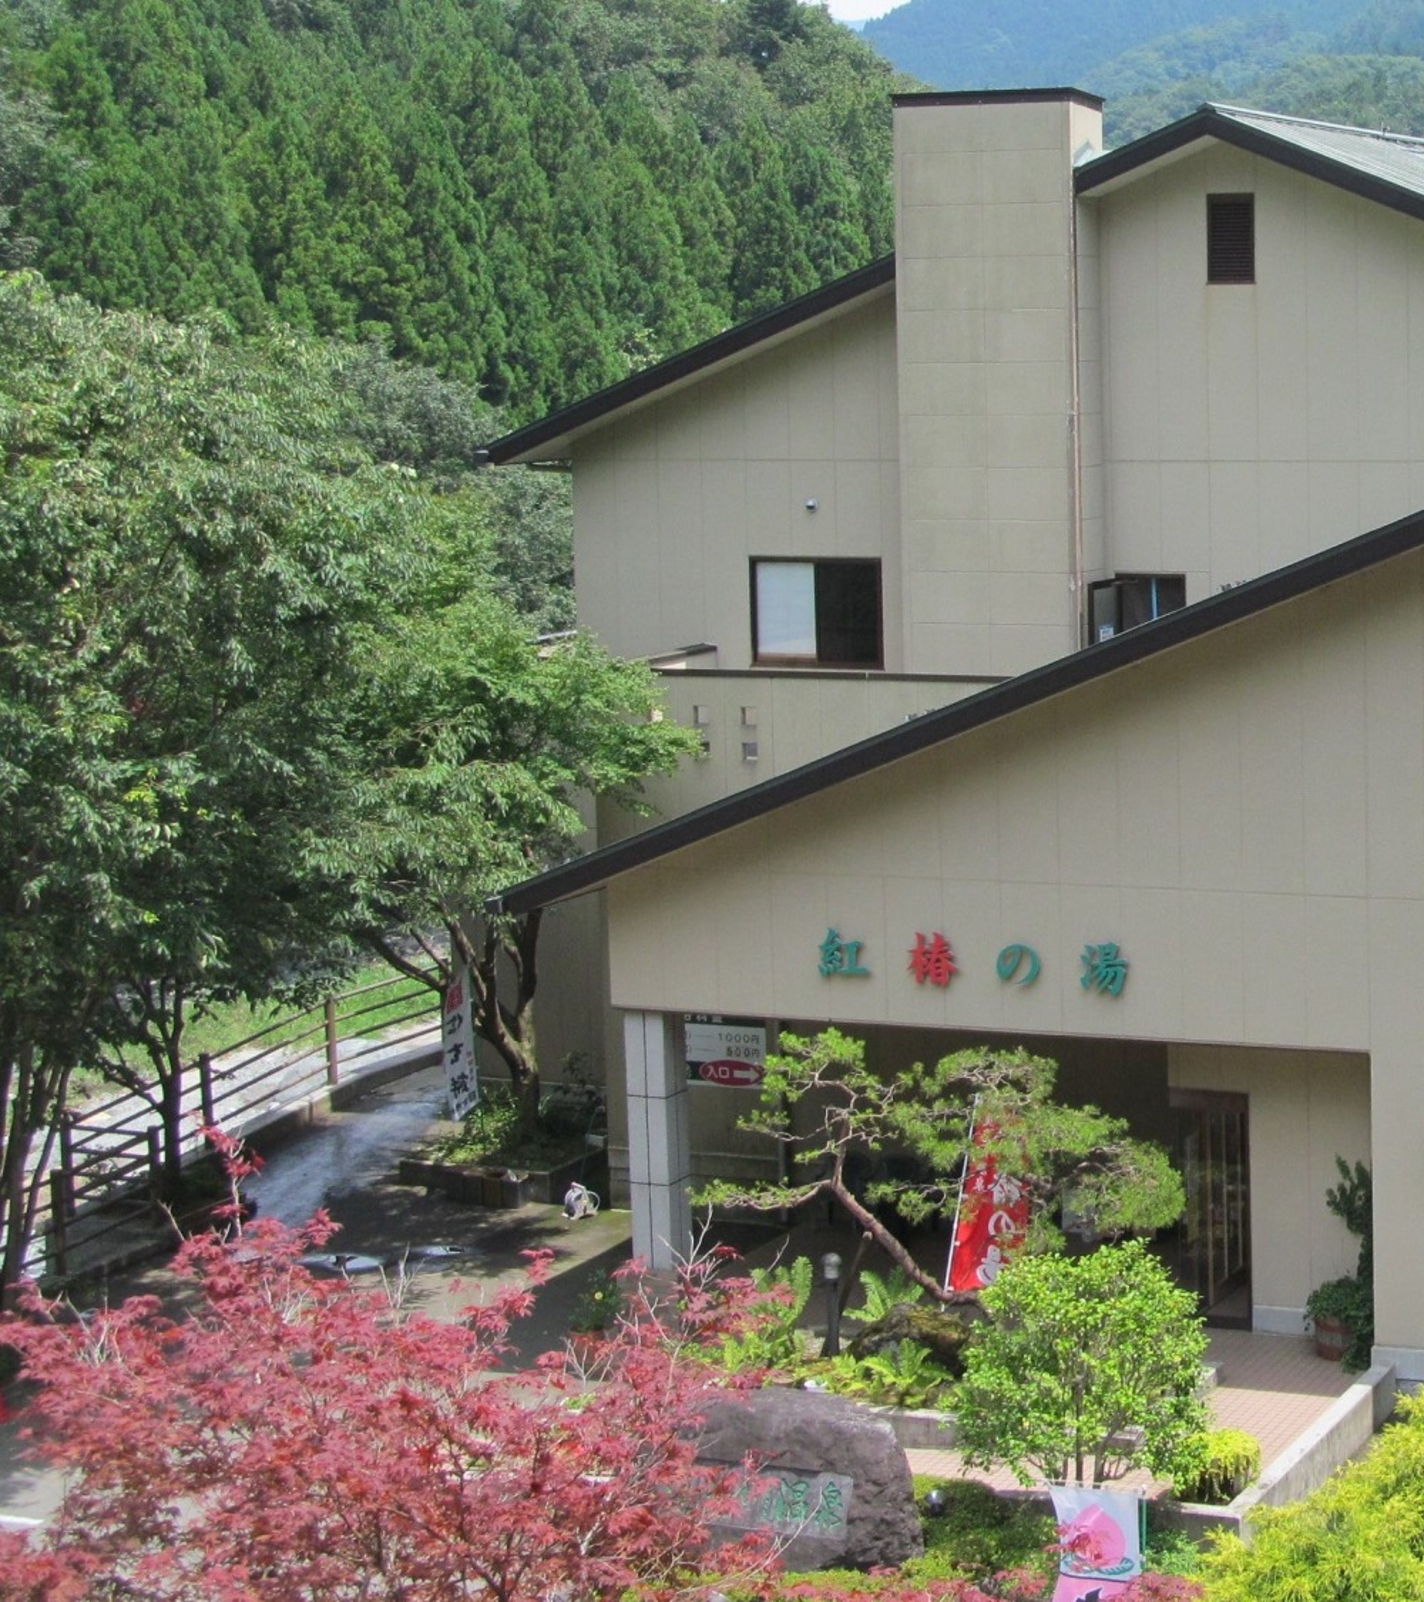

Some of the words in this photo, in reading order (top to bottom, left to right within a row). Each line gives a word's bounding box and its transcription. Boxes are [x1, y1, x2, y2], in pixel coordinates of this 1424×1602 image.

[818, 926, 1127, 997] 紅椿の湯
[706, 1065, 730, 1079] 入口
